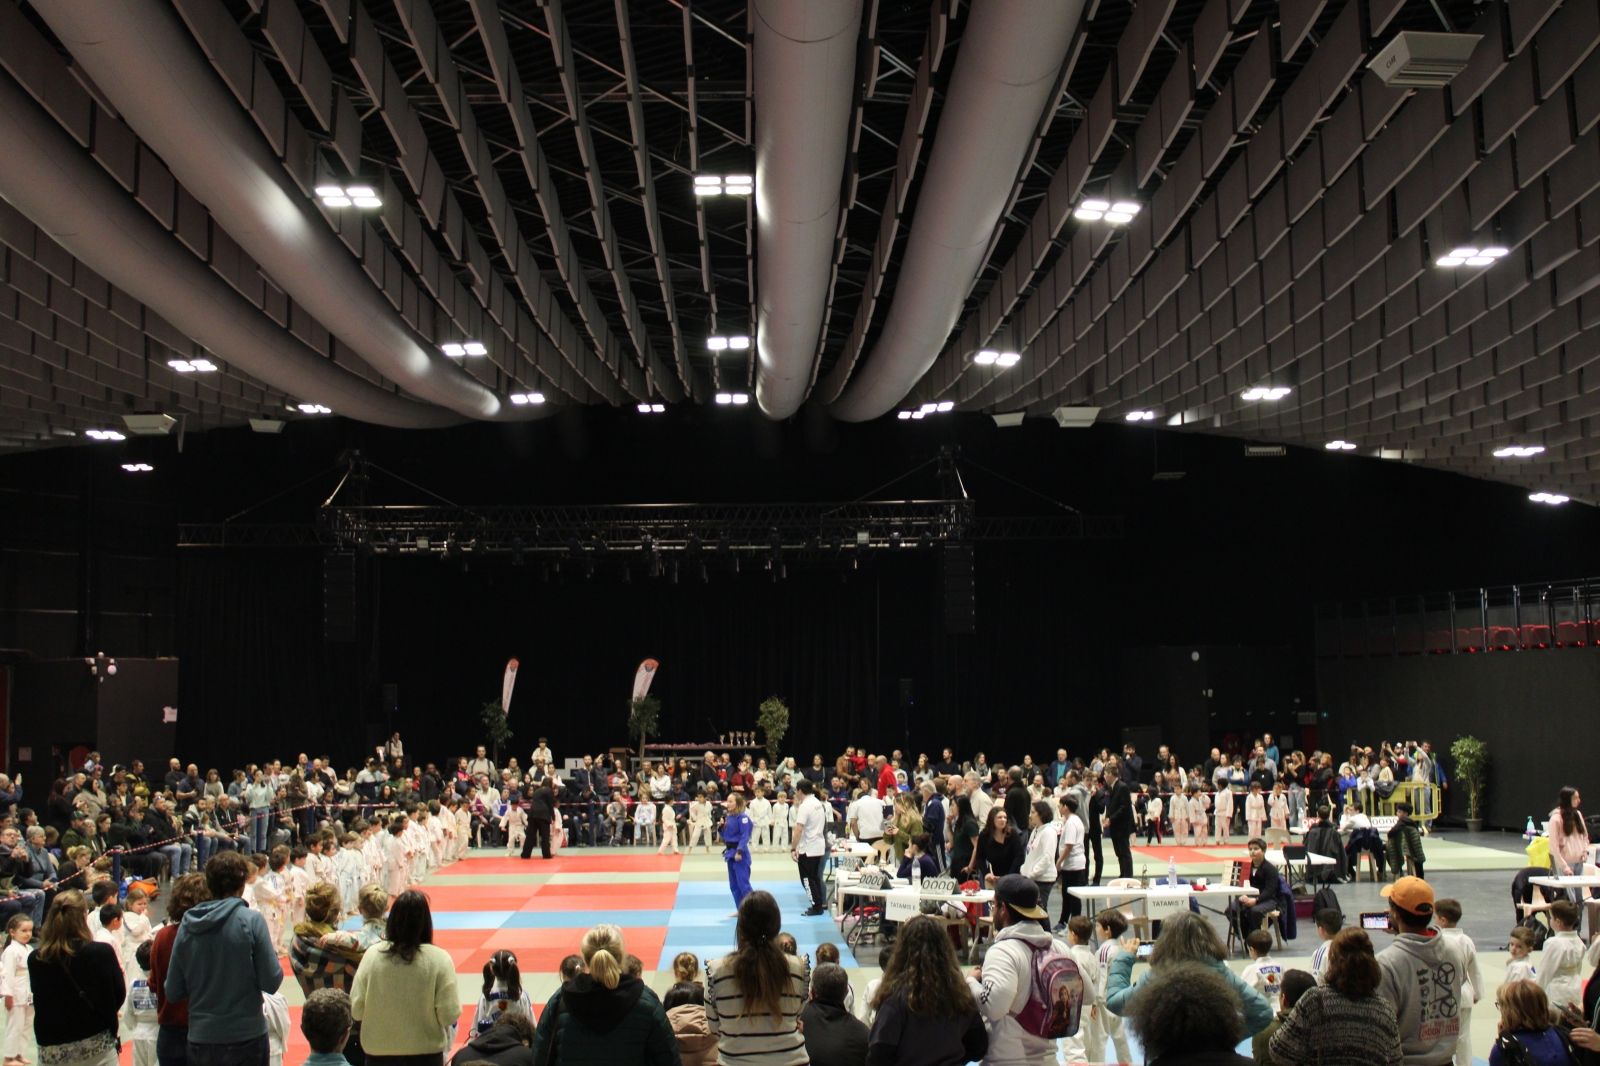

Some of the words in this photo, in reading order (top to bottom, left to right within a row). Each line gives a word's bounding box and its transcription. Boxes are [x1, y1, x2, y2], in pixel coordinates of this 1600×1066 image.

[860, 874, 883, 886] 0000
[922, 879, 954, 891] 0000
[890, 901, 911, 910] TATAMIS
